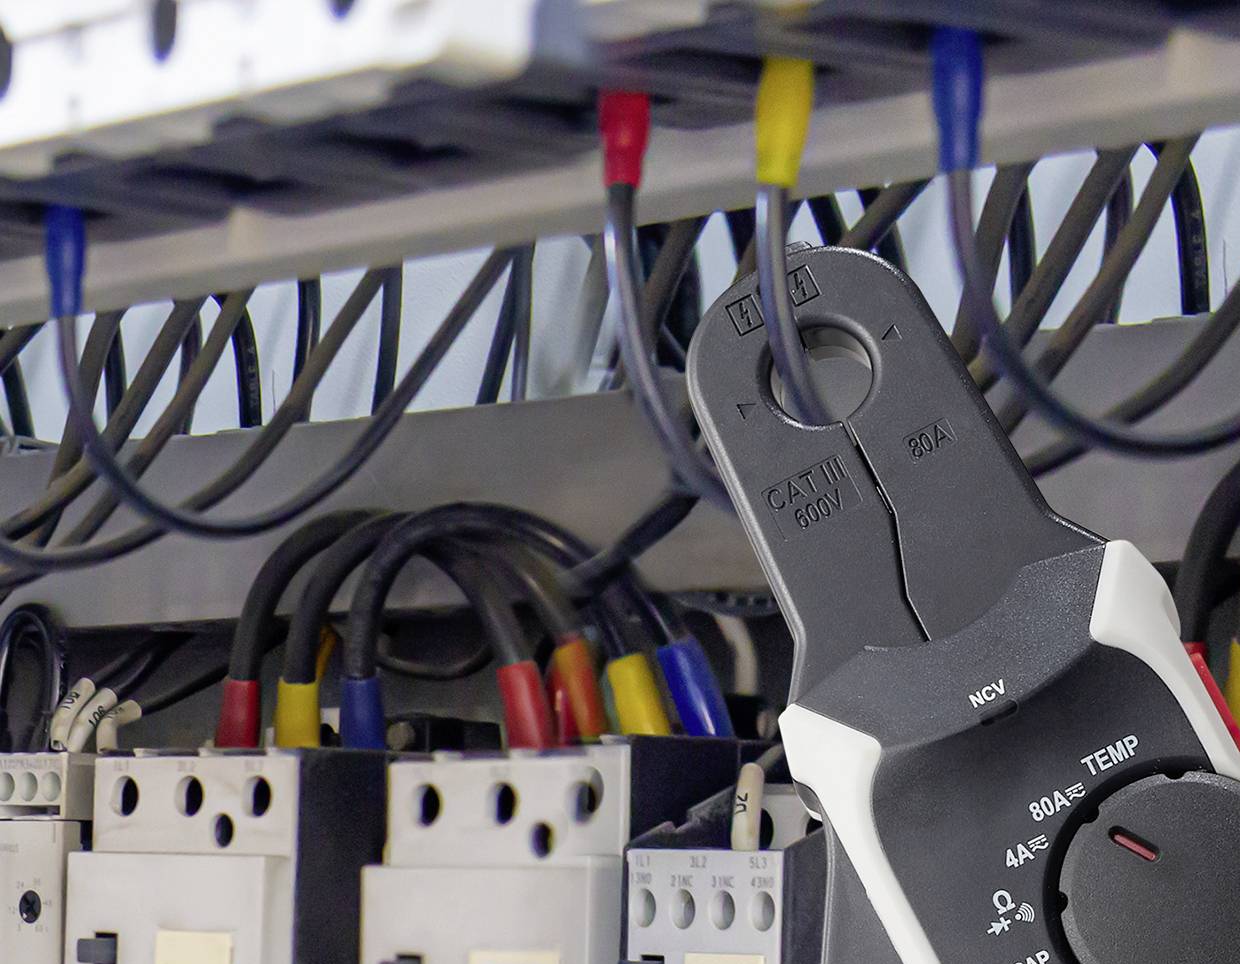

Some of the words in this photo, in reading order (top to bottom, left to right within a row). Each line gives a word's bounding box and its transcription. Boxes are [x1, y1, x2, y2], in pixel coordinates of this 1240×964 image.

[908, 423, 953, 458] 80A
[767, 470, 818, 512] CAT
[820, 456, 848, 484] III
[795, 489, 843, 529] 600V
[968, 679, 1006, 708] NCV
[1080, 734, 1139, 776] TEMP
